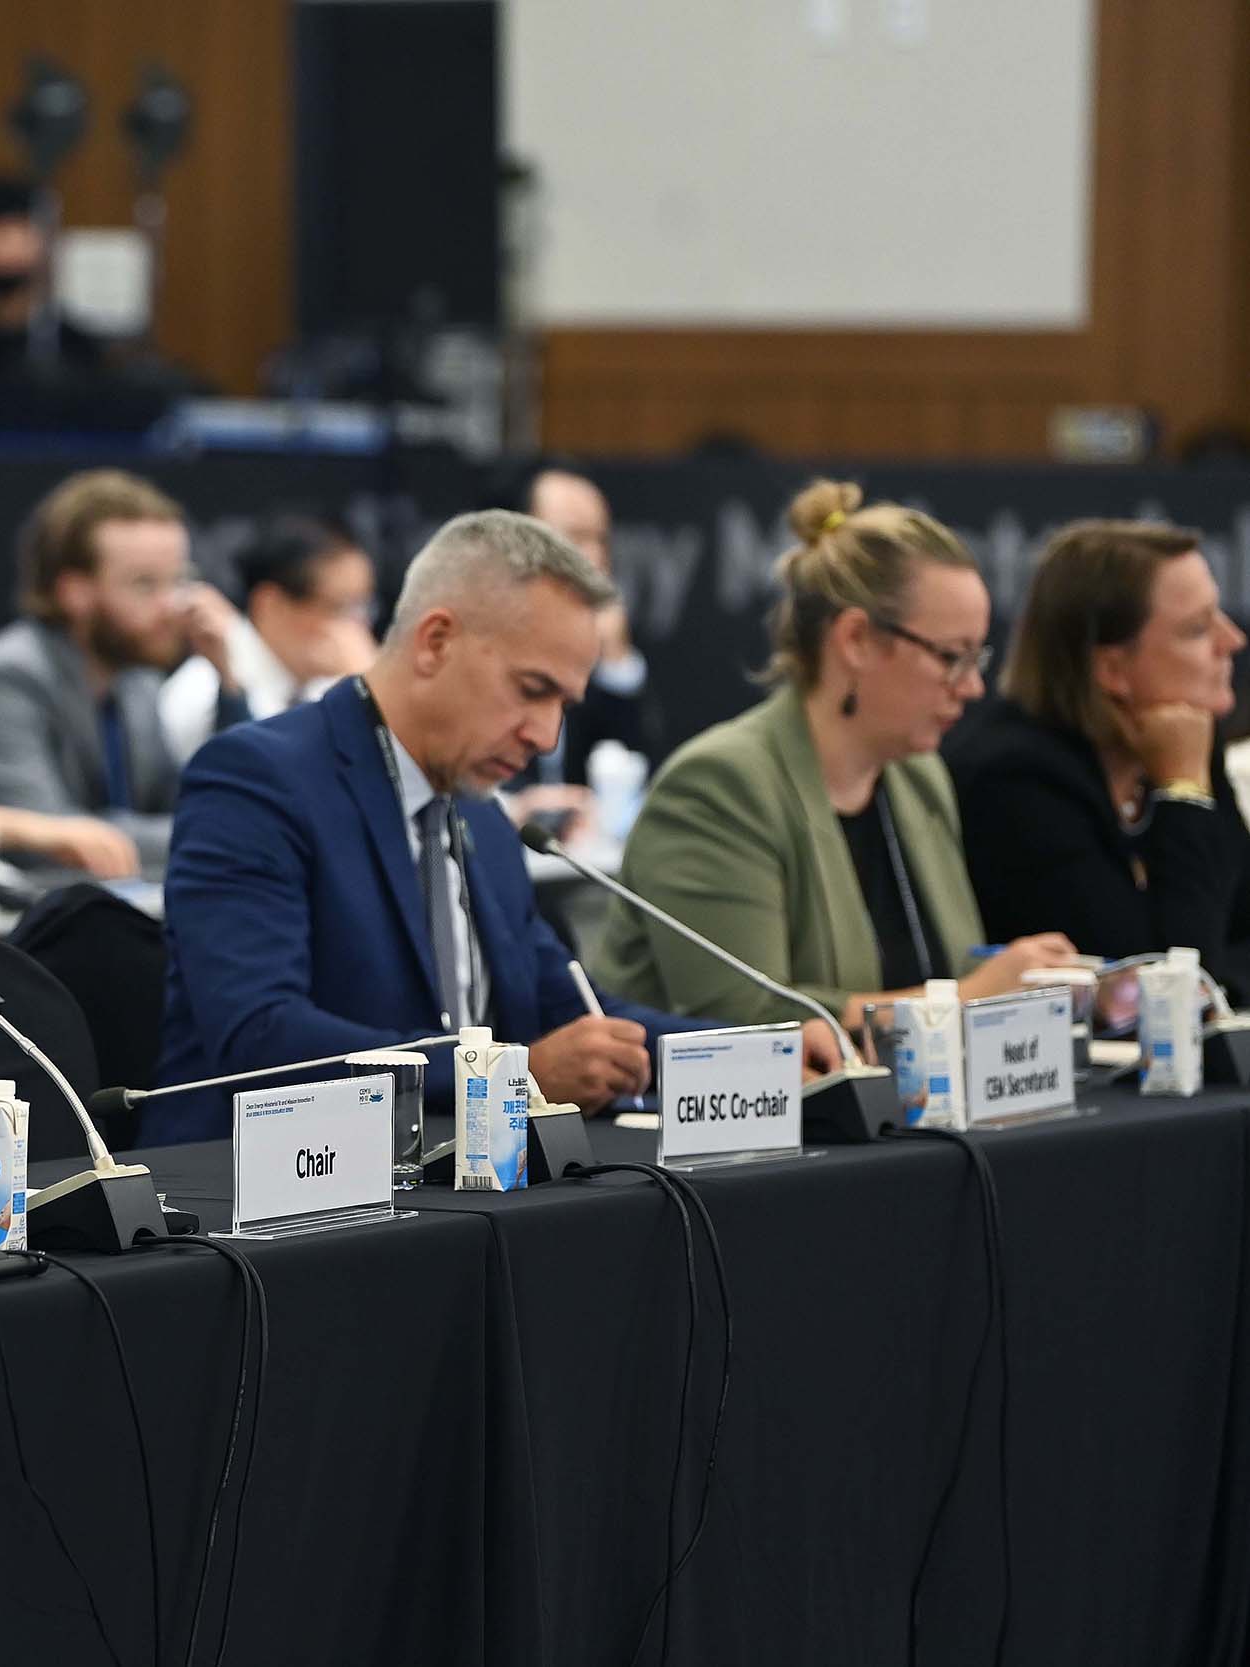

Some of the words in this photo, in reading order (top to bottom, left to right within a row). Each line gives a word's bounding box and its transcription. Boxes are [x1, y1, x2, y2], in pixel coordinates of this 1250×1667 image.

[677, 1095, 706, 1124] CEM
[710, 1093, 727, 1121] SC
[731, 1088, 789, 1119] Co-chair
[296, 1144, 336, 1179] Chair
